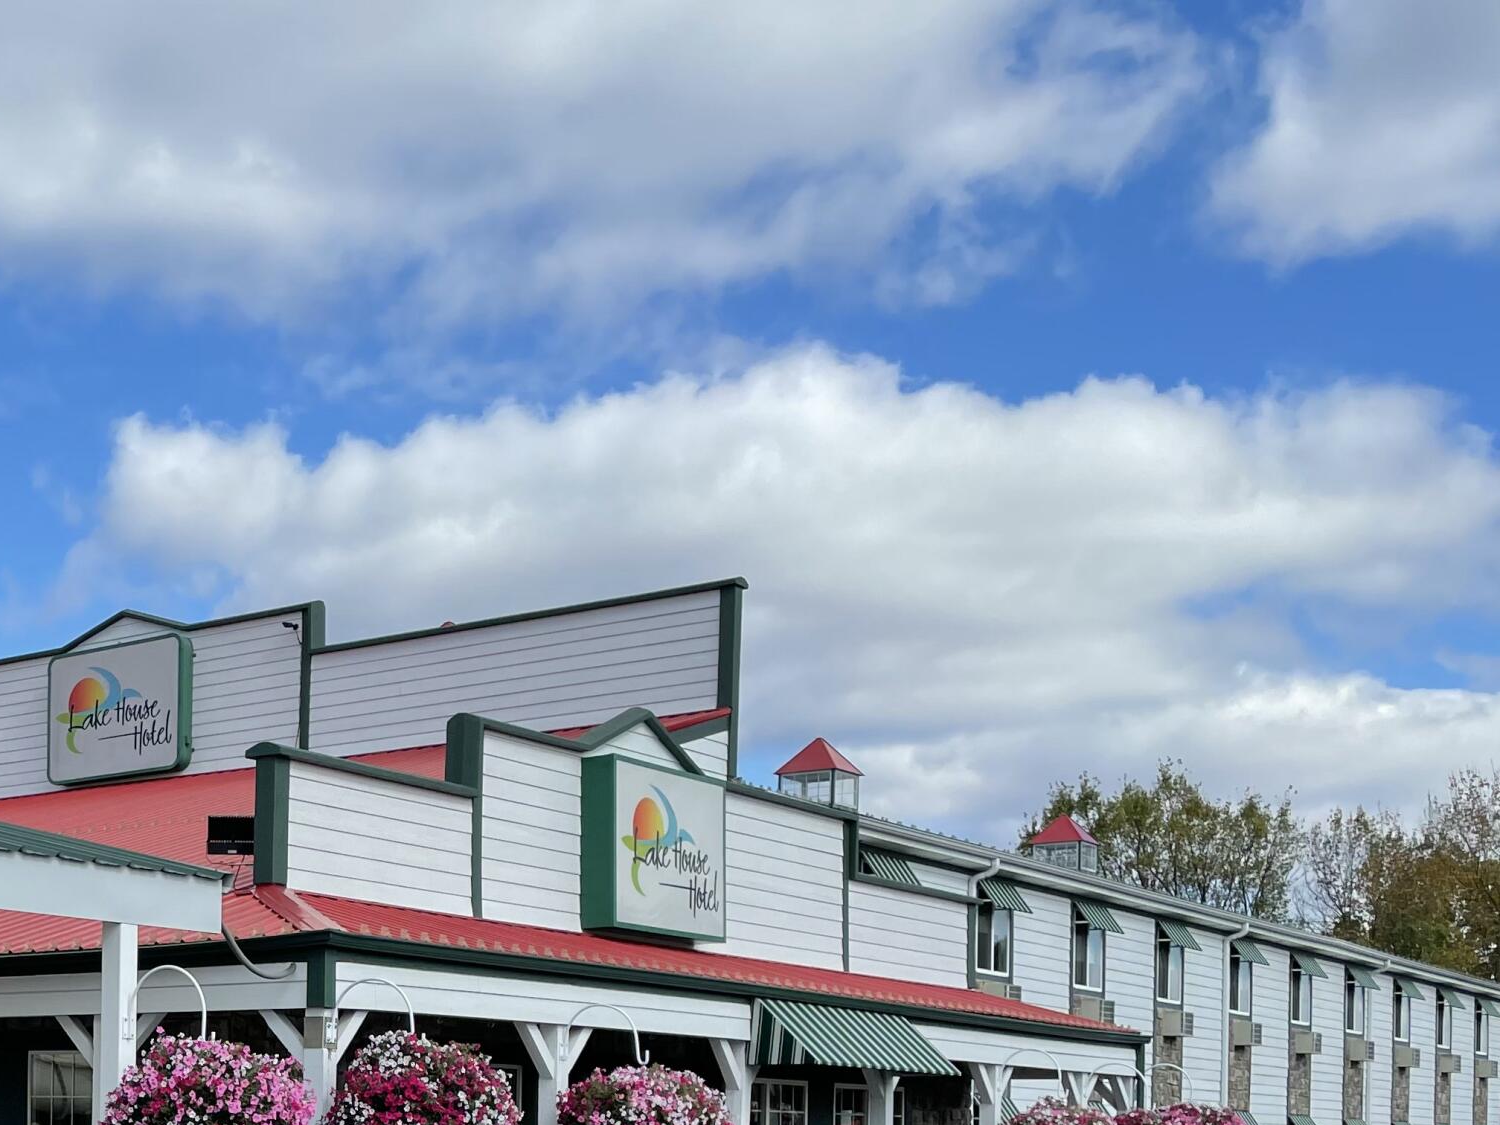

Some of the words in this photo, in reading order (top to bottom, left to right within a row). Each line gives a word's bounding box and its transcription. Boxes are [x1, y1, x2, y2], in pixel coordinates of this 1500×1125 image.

[68, 699, 112, 733] Lake
[115, 696, 160, 726] House
[132, 709, 172, 755] Hotel
[633, 826, 671, 870] Lake
[672, 836, 710, 875] House
[687, 870, 719, 918] Hotel
